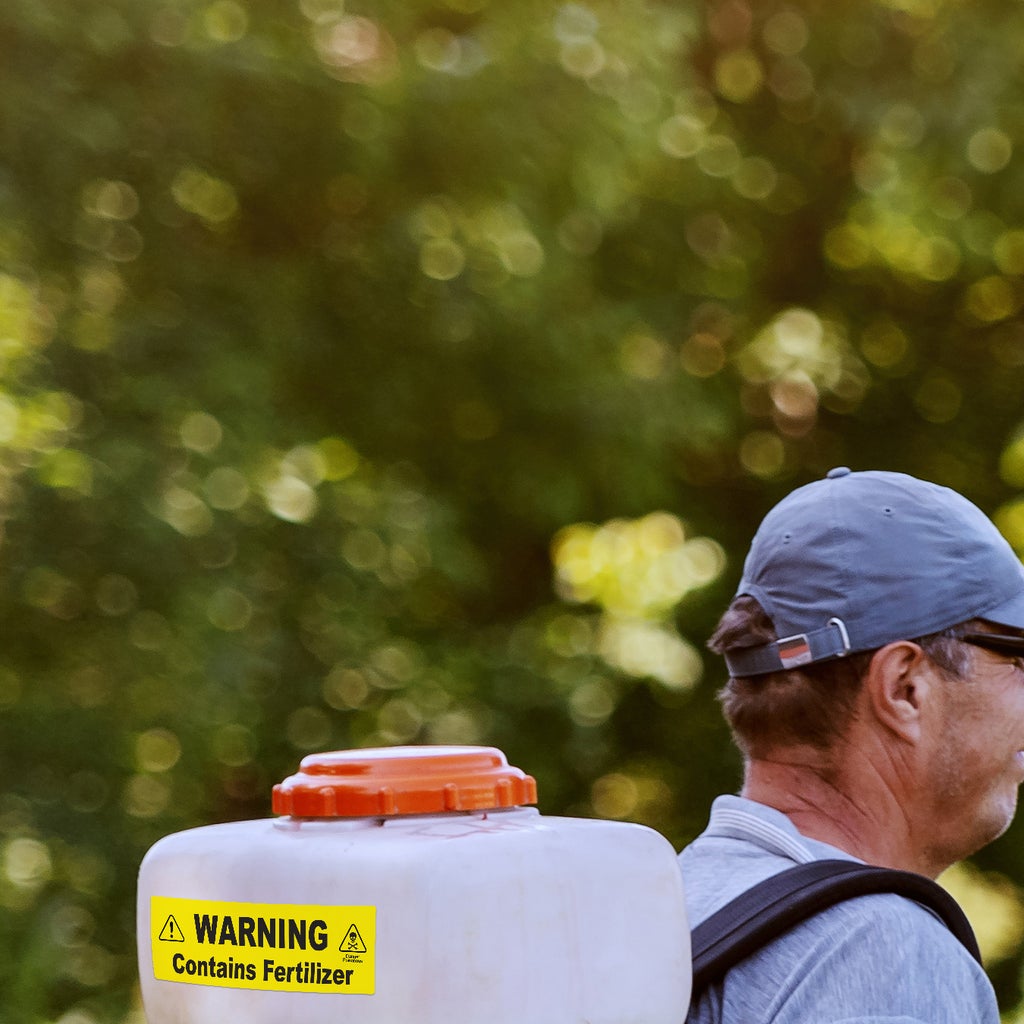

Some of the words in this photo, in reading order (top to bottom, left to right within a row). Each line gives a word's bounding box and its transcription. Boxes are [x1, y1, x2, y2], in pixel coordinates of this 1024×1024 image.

[193, 913, 328, 951] WARNING
[172, 953, 257, 981] Contains
[263, 959, 354, 986] Fertilizer
